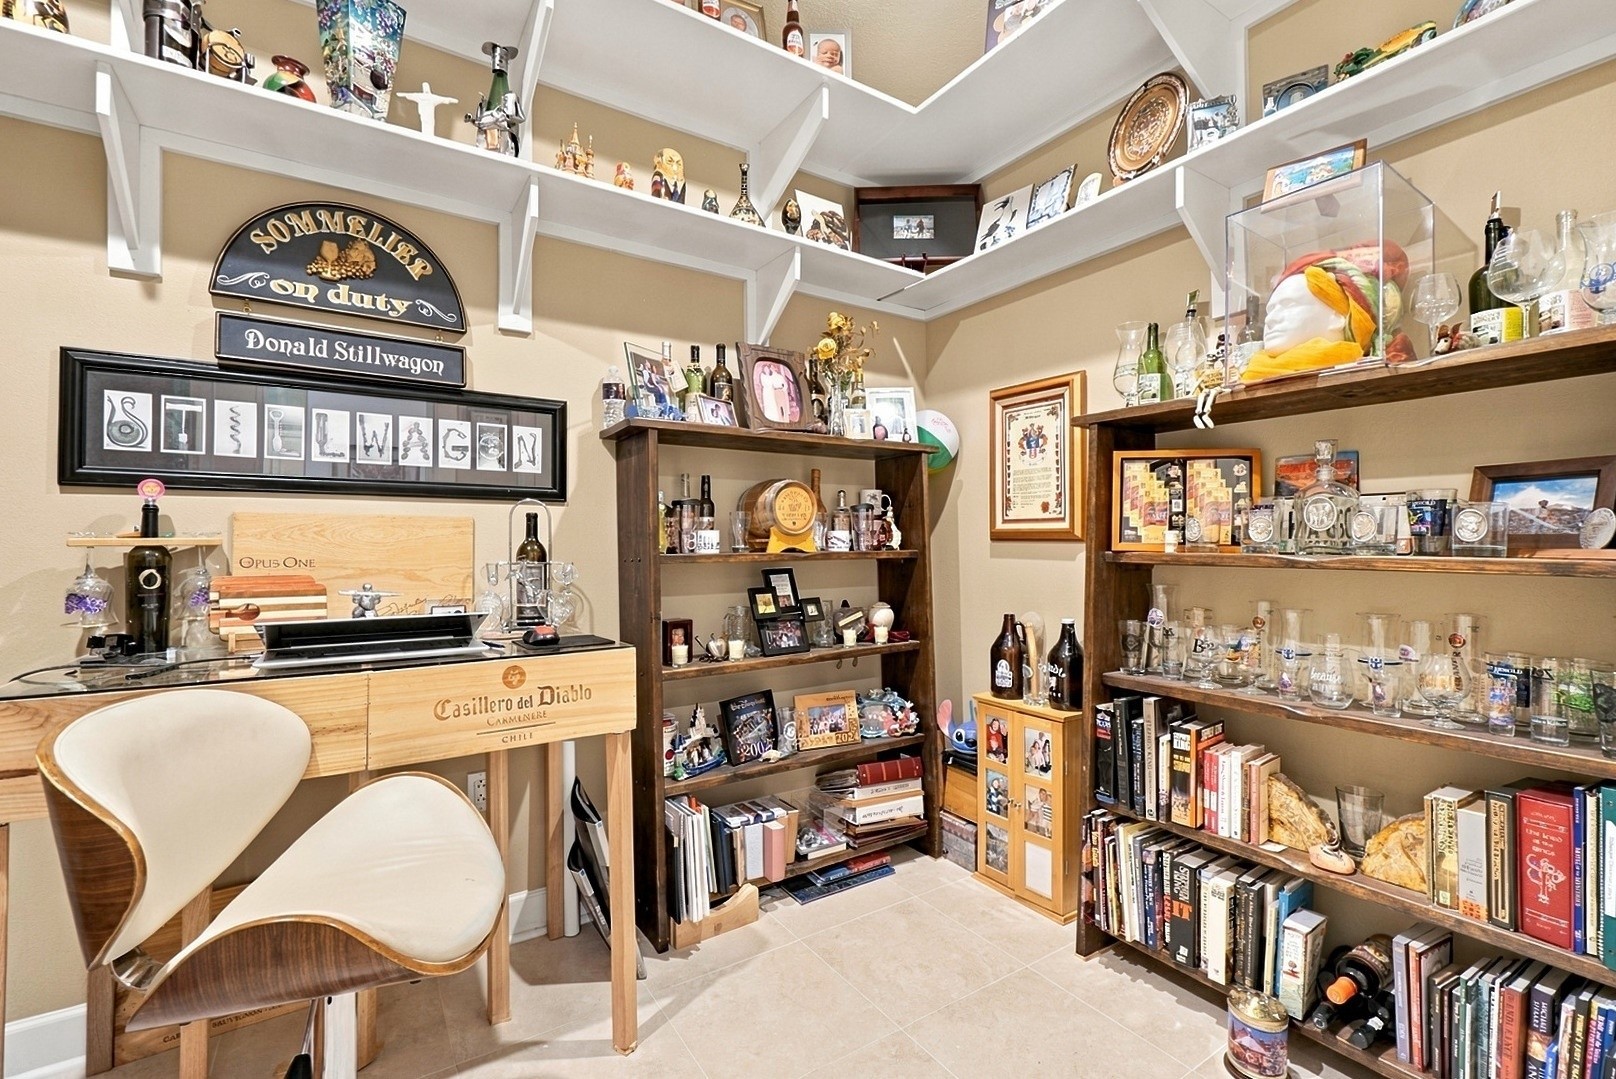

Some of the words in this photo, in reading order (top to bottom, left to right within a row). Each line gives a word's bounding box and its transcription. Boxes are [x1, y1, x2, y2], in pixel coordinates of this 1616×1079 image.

[250, 209, 434, 281] SOMMELIER
[269, 278, 320, 303] on
[326, 283, 413, 318] duty
[244, 328, 329, 359] Donald
[333, 340, 445, 376] Stillwagon
[433, 694, 513, 722] Casillero
[517, 694, 534, 710] del
[537, 683, 593, 708] Diablo
